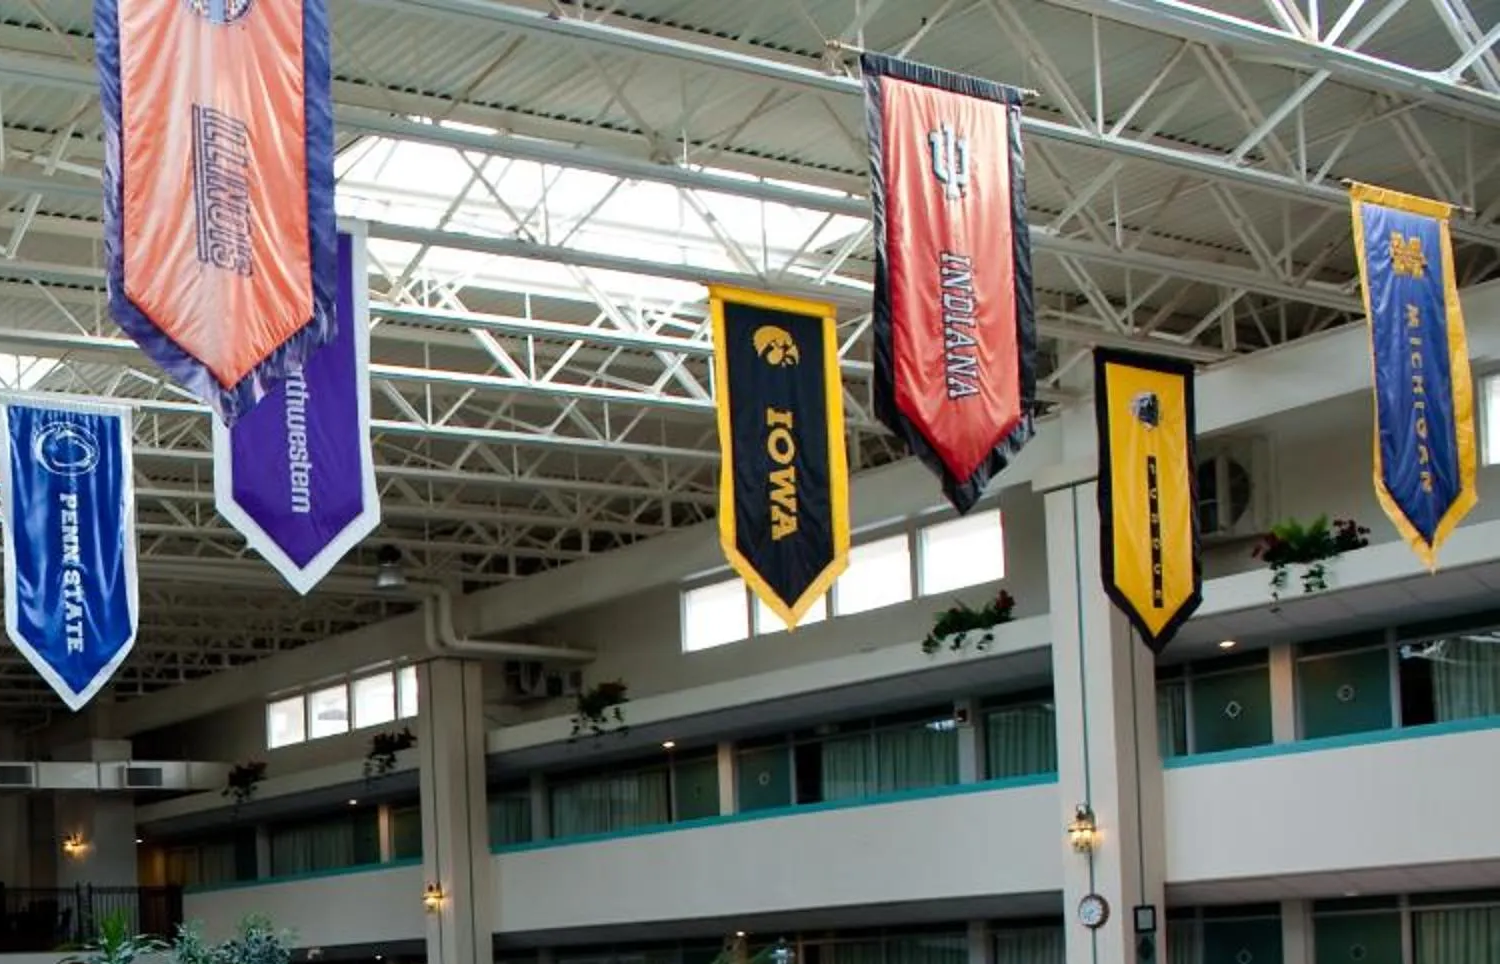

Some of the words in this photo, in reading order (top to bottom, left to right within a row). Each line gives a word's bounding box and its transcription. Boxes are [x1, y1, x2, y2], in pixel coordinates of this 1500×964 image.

[201, 107, 253, 277] ILLINOIS
[940, 250, 980, 400] INDIANA
[60, 493, 81, 567] PENN
[766, 407, 798, 541] IOWA
[64, 568, 85, 656] STATE
